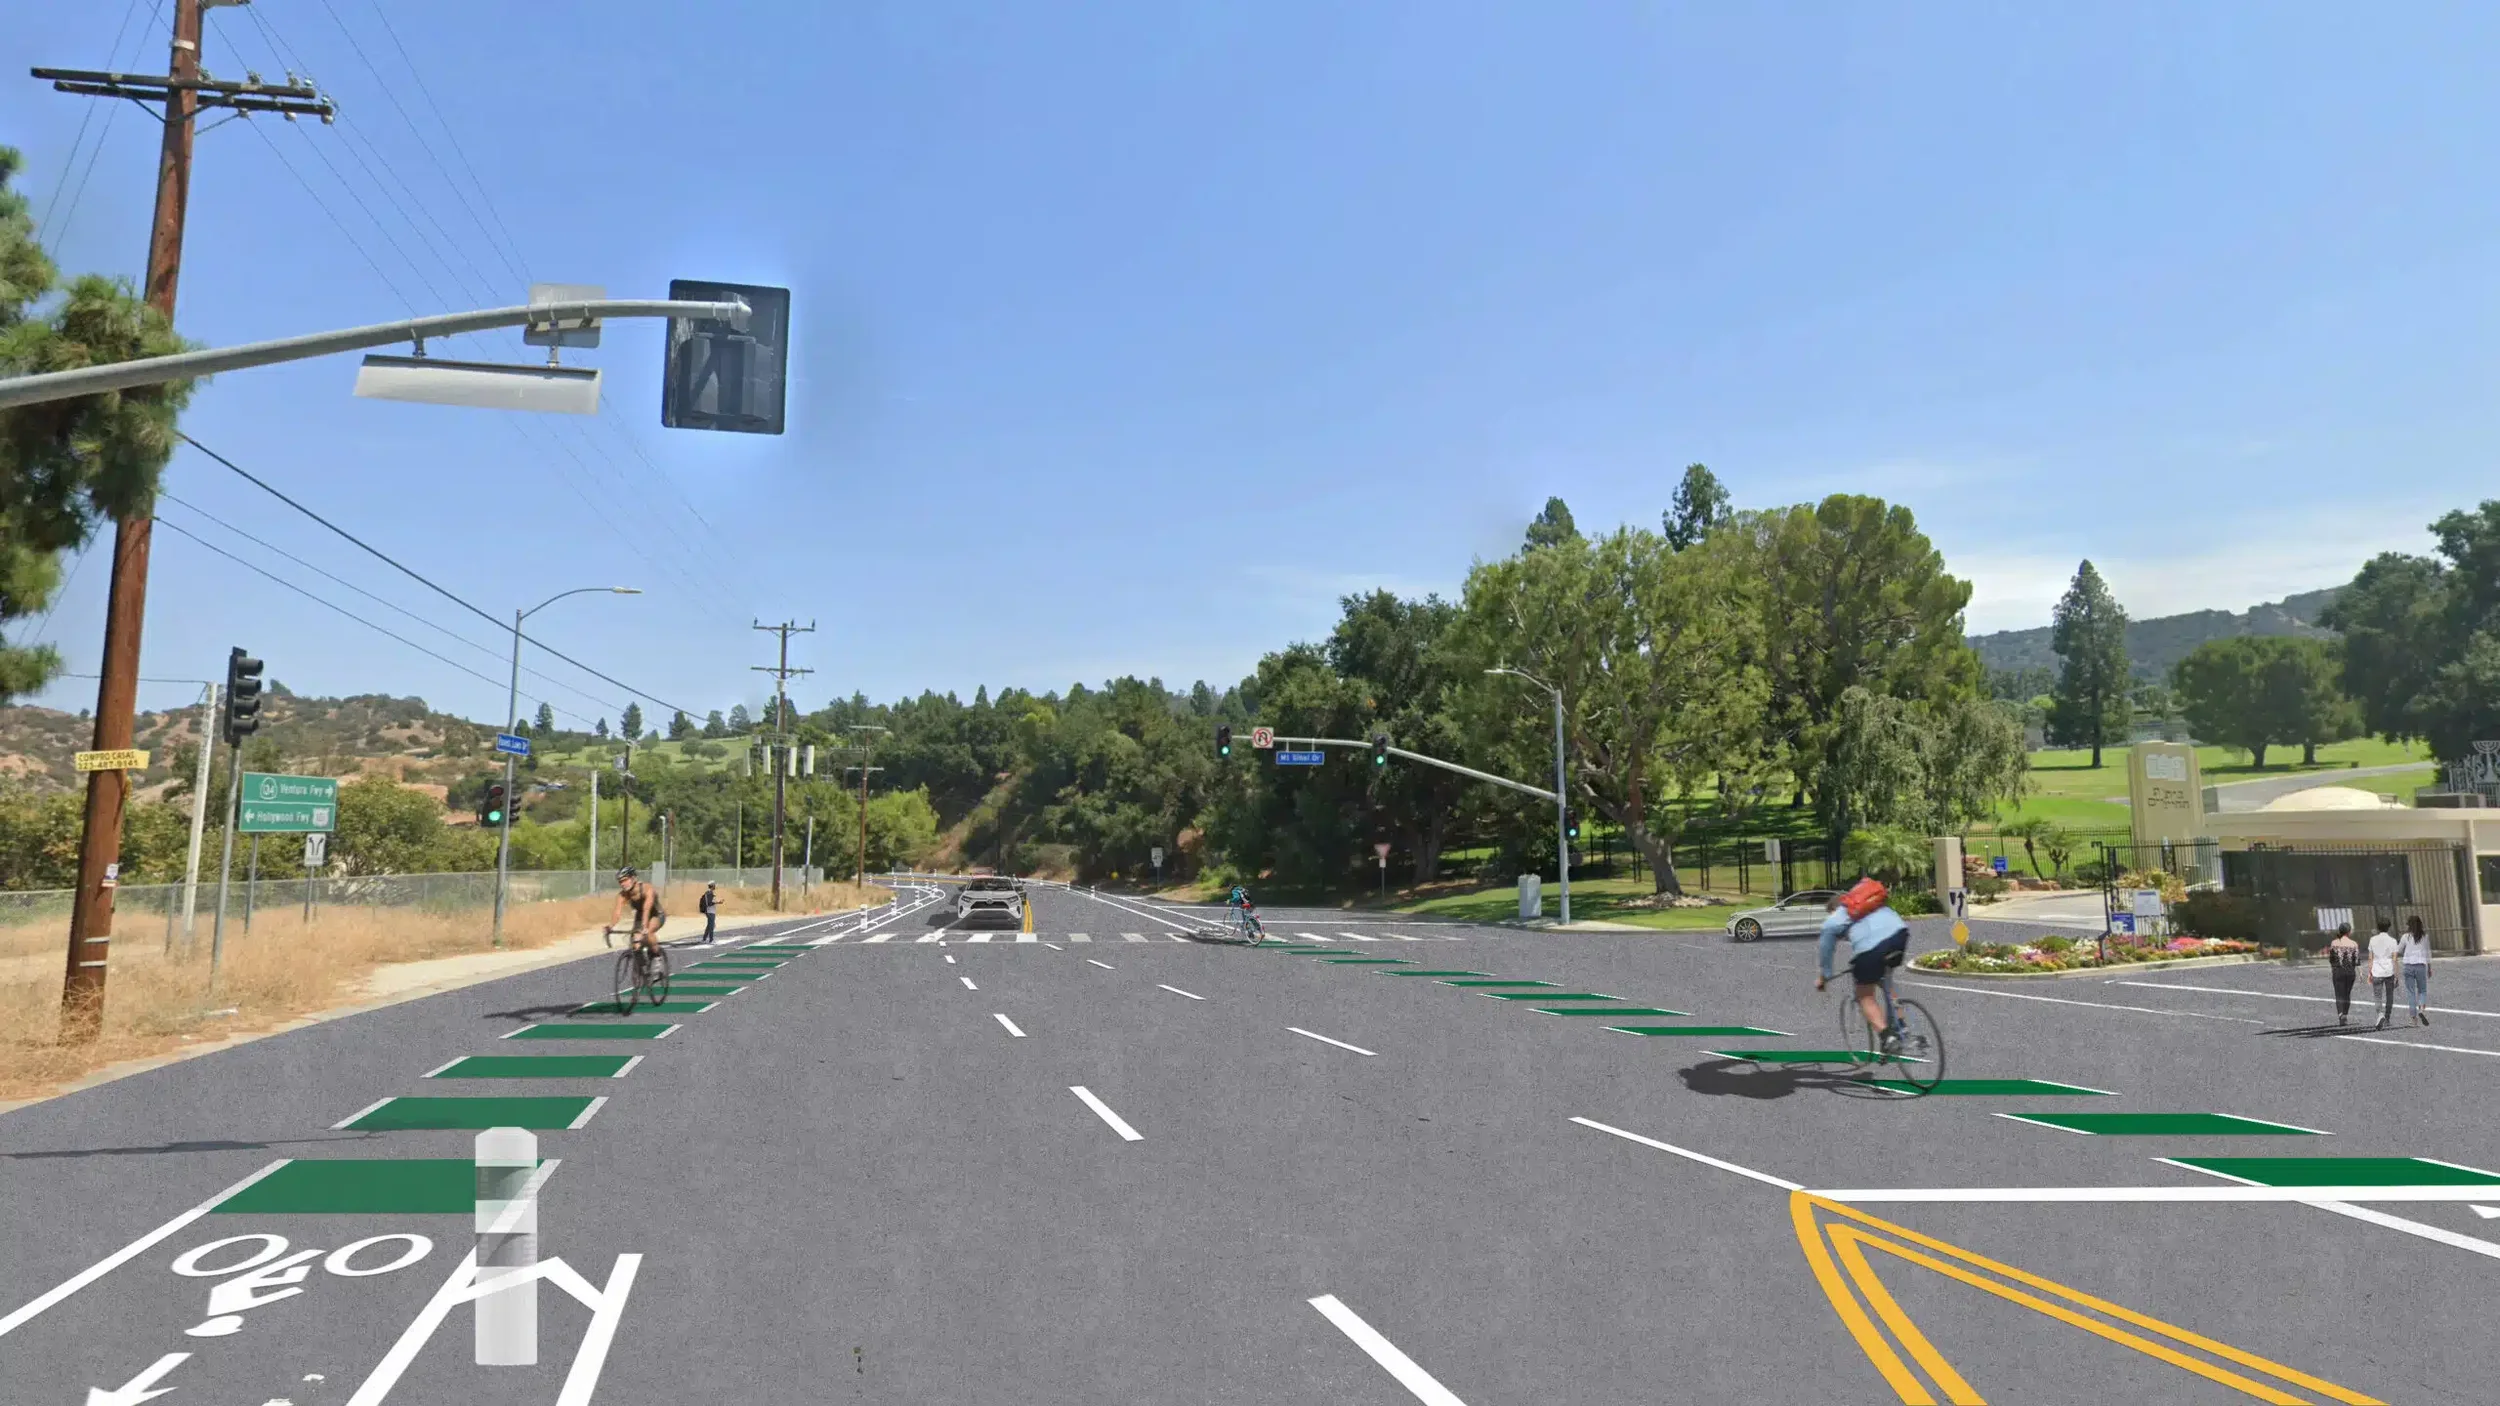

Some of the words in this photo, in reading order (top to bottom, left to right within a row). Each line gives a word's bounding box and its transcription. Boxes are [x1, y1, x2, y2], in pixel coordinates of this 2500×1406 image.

[78, 752, 110, 762] COMPRO
[112, 751, 135, 760] CASAS
[1311, 753, 1320, 761] Dr
[280, 784, 308, 795] Ventura
[310, 785, 324, 797] Fwy
[257, 810, 295, 823] Hollywood
[296, 812, 310, 823] Fwy
